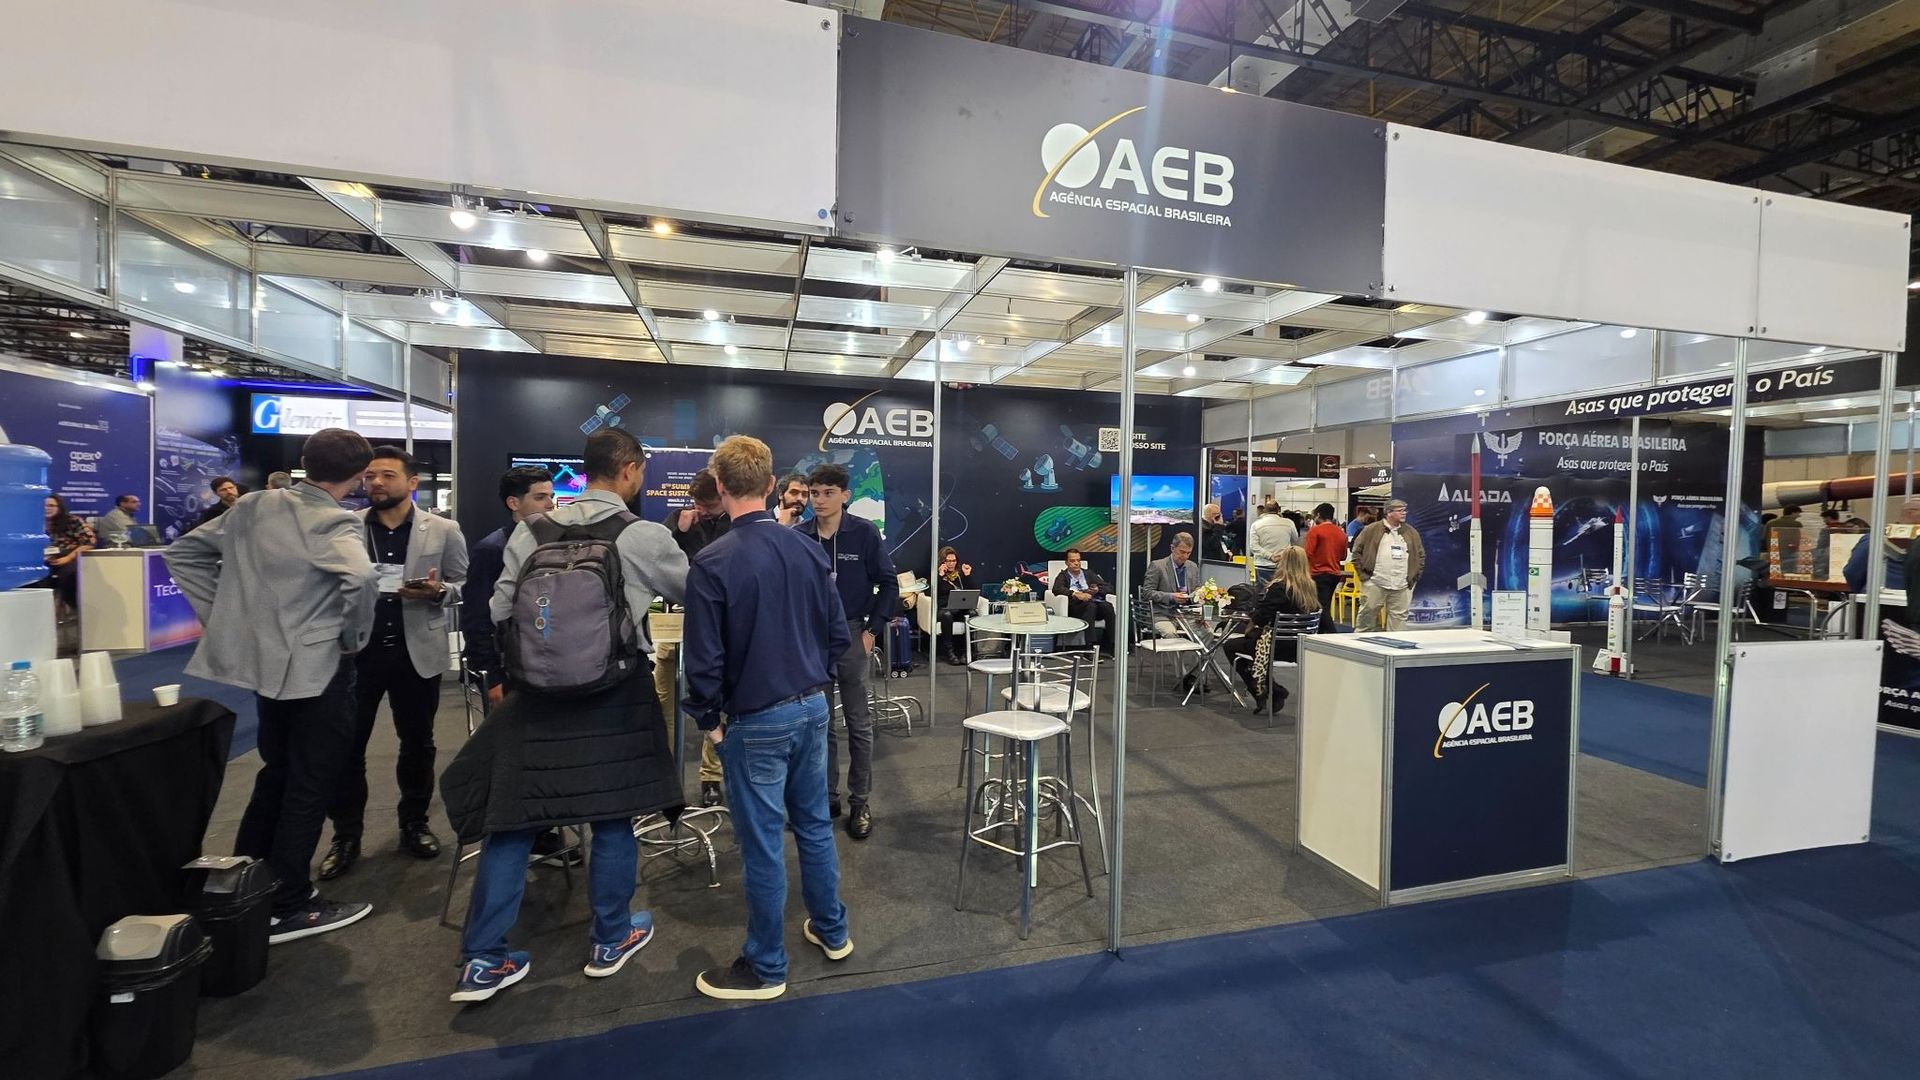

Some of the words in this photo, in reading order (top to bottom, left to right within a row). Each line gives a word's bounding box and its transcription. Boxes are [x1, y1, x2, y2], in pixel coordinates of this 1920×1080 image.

[1099, 138, 1235, 206] AEB
[1049, 191, 1103, 209] AGÊNCIA
[1105, 199, 1162, 218] ESPACIAL
[1164, 210, 1232, 228] BRASILEIRA
[1565, 400, 1605, 416] Asas
[1608, 394, 1643, 415] que
[1755, 377, 1772, 393] o
[1778, 365, 1835, 391] País
[254, 399, 343, 431] Glenair
[856, 407, 934, 437] AEB
[828, 437, 859, 445] AGÊNCIA
[1150, 443, 1168, 451] SITE
[1538, 431, 1579, 450] FORÇA
[1582, 430, 1620, 449] AÉREA
[1622, 435, 1687, 452] BASILEIRA
[70, 451, 96, 462] apex
[70, 460, 97, 472] Brasil
[1557, 457, 1579, 470] Asas
[1580, 460, 1597, 472] que
[1641, 462, 1648, 471] o
[1649, 460, 1669, 473] País
[1466, 700, 1535, 735] AEB
[1442, 739, 1469, 749] AGÊNCIA
[1469, 737, 1498, 746] ESPACIAL
[1498, 734, 1532, 743] BRASILEIRA
